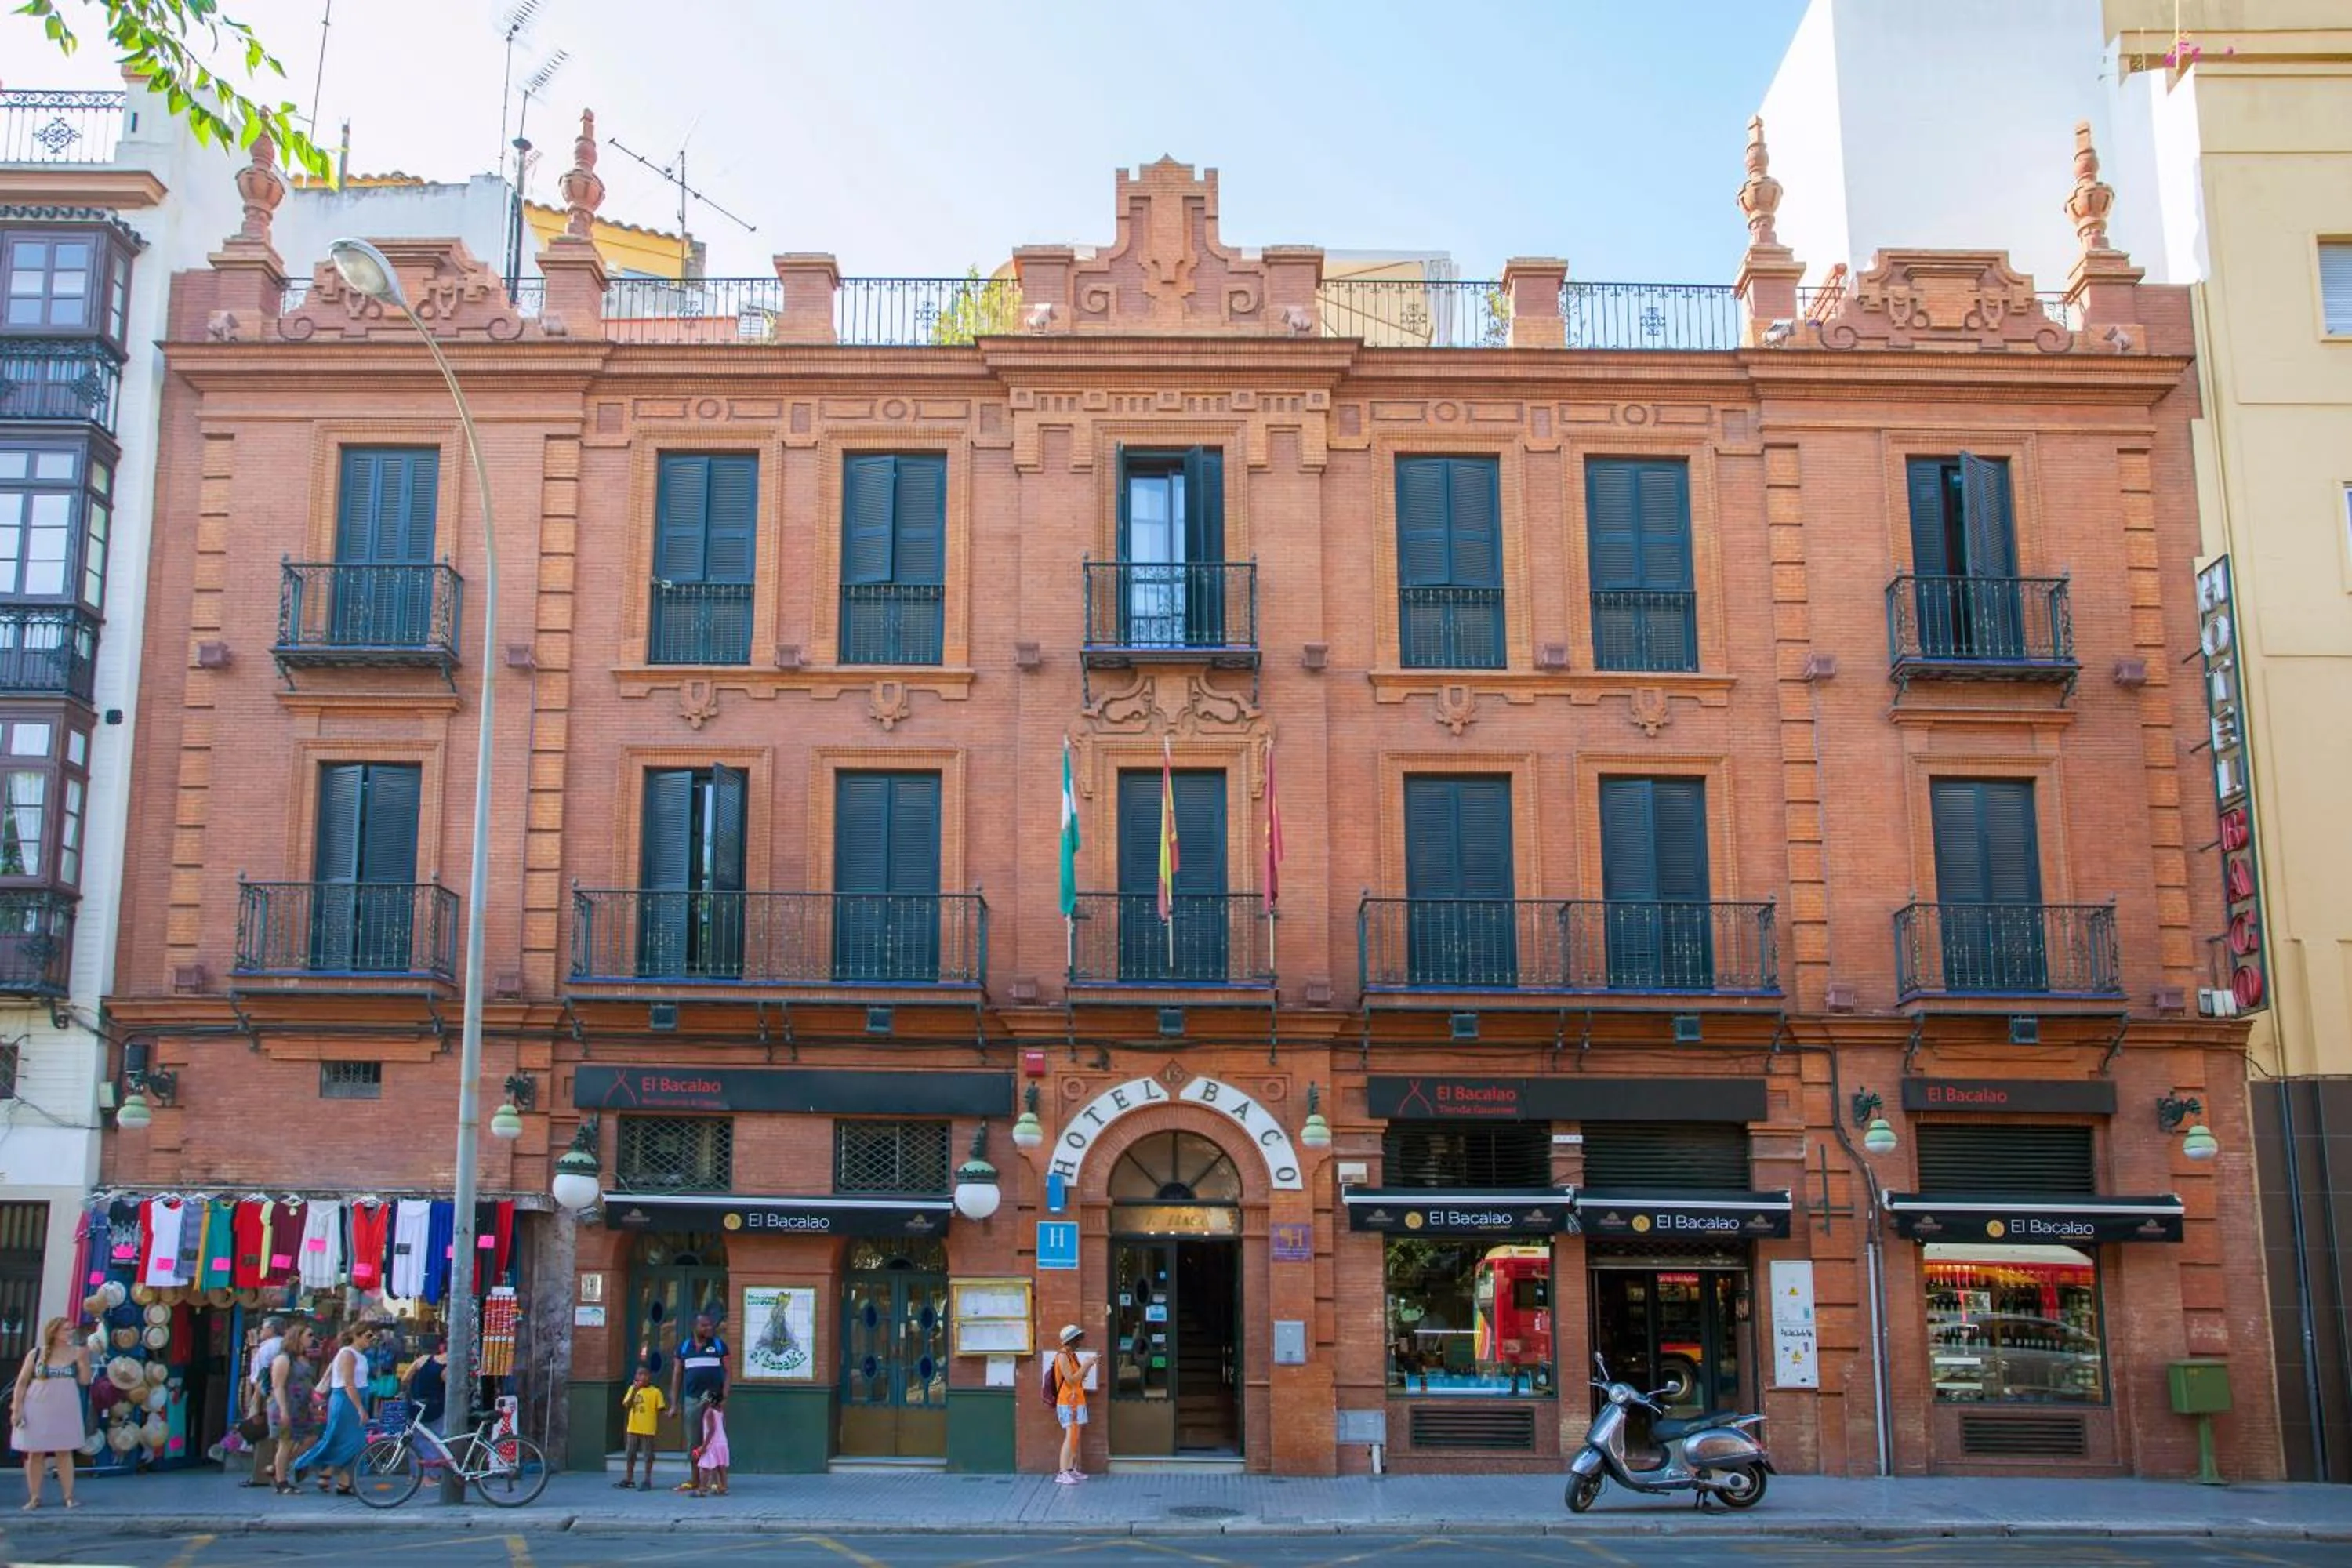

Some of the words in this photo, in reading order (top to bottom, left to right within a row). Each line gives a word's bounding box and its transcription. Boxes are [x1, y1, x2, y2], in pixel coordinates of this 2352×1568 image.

[2198, 563, 2243, 799] HOTEL
[2221, 808, 2263, 1007] BACO
[641, 1076, 655, 1091] El
[660, 1077, 721, 1092] Bacalao
[1436, 1086, 1450, 1101] El
[1454, 1086, 1516, 1102] Bacalao
[1927, 1087, 1941, 1102] El
[1946, 1087, 2007, 1103] Bacalao
[1053, 1080, 1161, 1179] HOTEL
[1200, 1080, 1297, 1182] BACO
[749, 1213, 763, 1227] El
[767, 1213, 830, 1229] Bacalao
[1429, 1211, 1443, 1225] El
[1448, 1211, 1512, 1225] Bacalao
[1657, 1214, 1671, 1229] El
[1675, 1214, 1740, 1230] Bacalao
[2011, 1219, 2025, 1233] El
[2030, 1219, 2095, 1235] Bacalao
[1049, 1227, 1065, 1247] H
